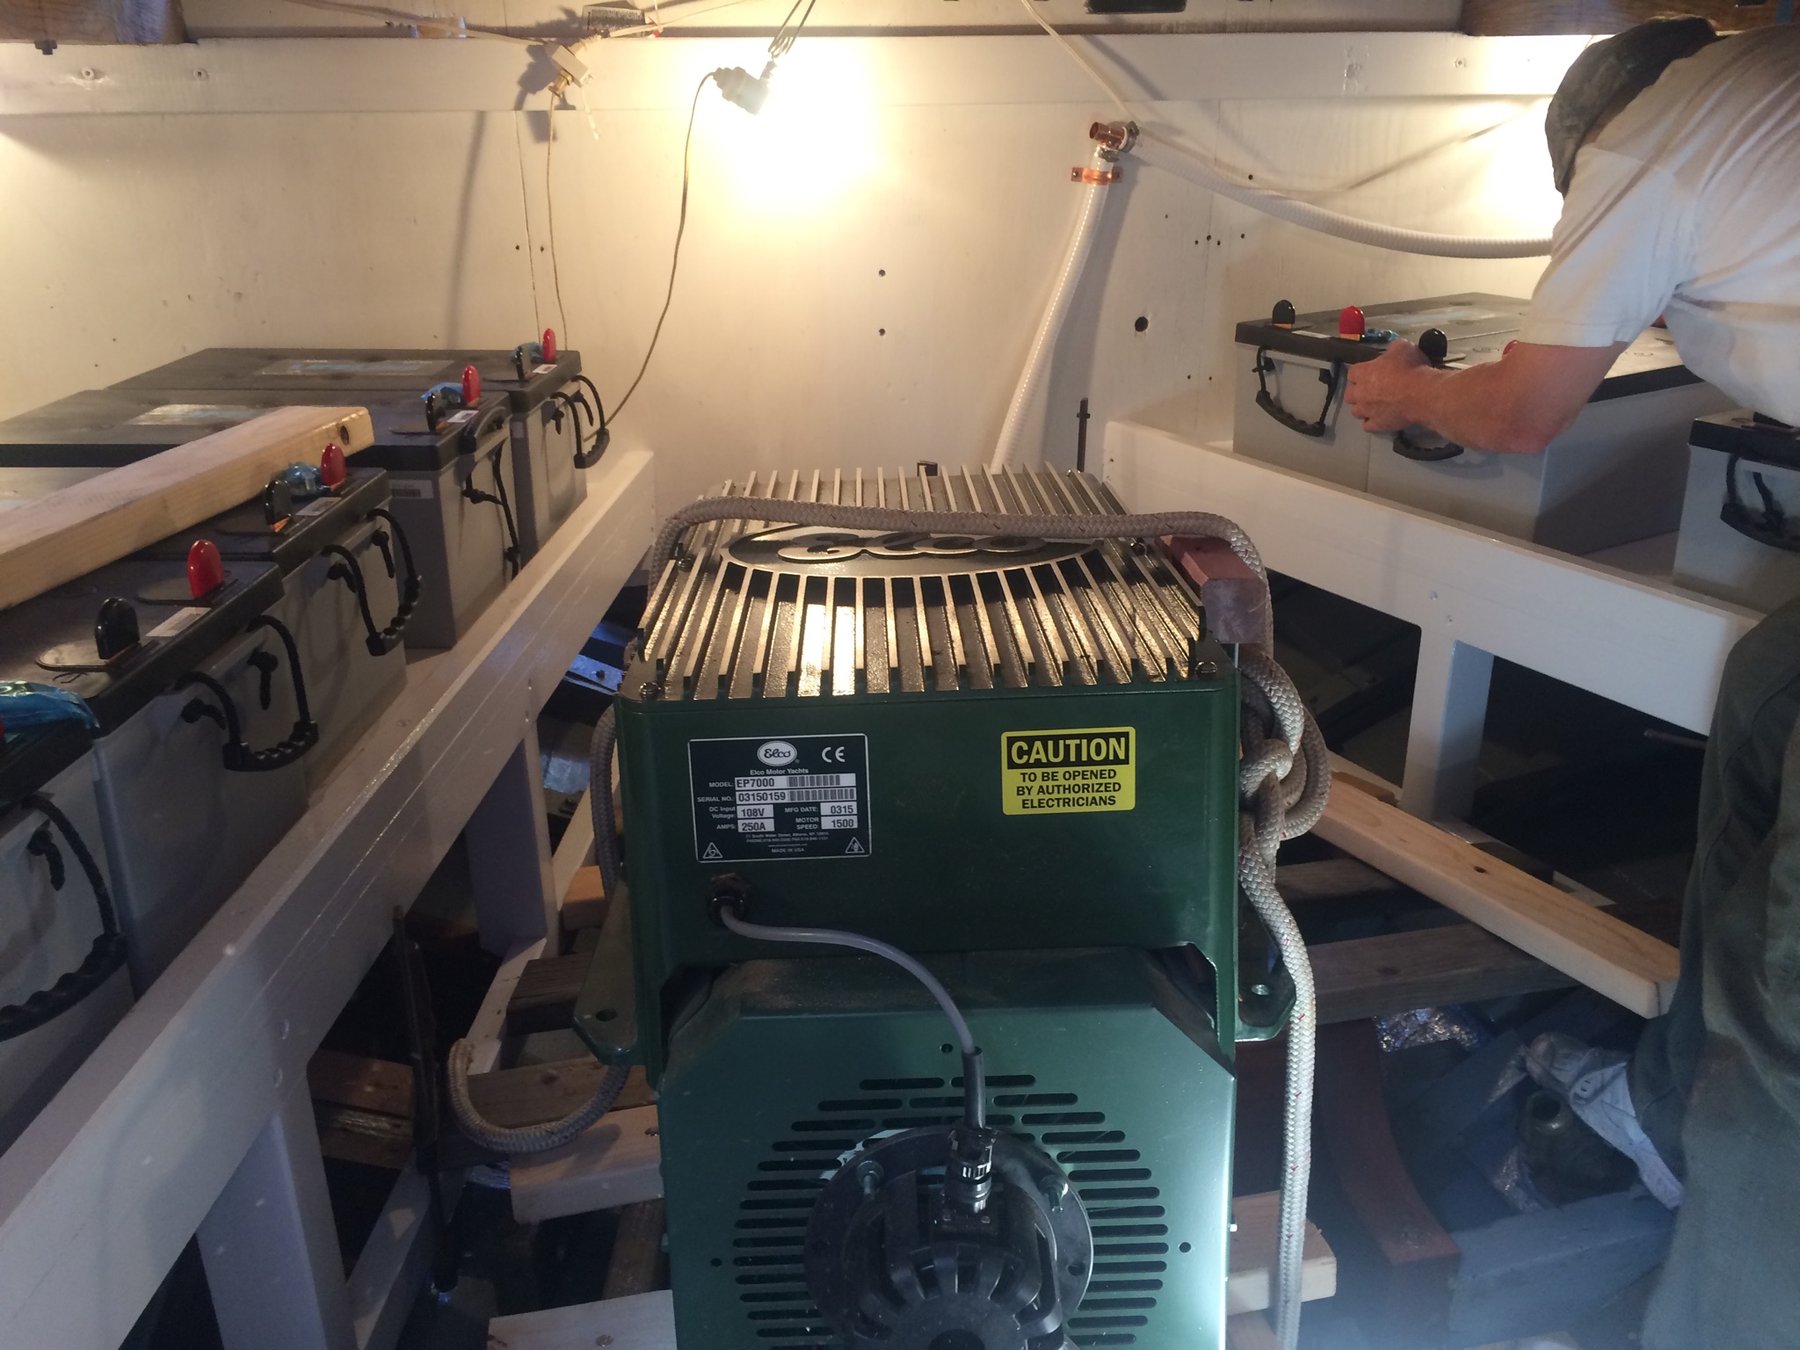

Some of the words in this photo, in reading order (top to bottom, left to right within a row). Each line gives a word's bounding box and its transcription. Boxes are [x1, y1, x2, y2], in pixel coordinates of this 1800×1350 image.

[764, 748, 791, 759] Elco
[1011, 737, 1126, 765] CAUTION
[1020, 772, 1037, 782] TO
[1041, 771, 1059, 782] BE
[1063, 769, 1117, 781] OPENED
[736, 777, 775, 788] EP7000
[1016, 786, 1034, 796] BY
[1036, 782, 1122, 796] AUTHORIZED
[738, 791, 787, 802] 03150159
[1021, 795, 1117, 809] ELECTRICIANS
[741, 808, 765, 817] 108V
[830, 805, 854, 815] 0315
[741, 822, 766, 832] 250A
[831, 819, 855, 828] 1500
